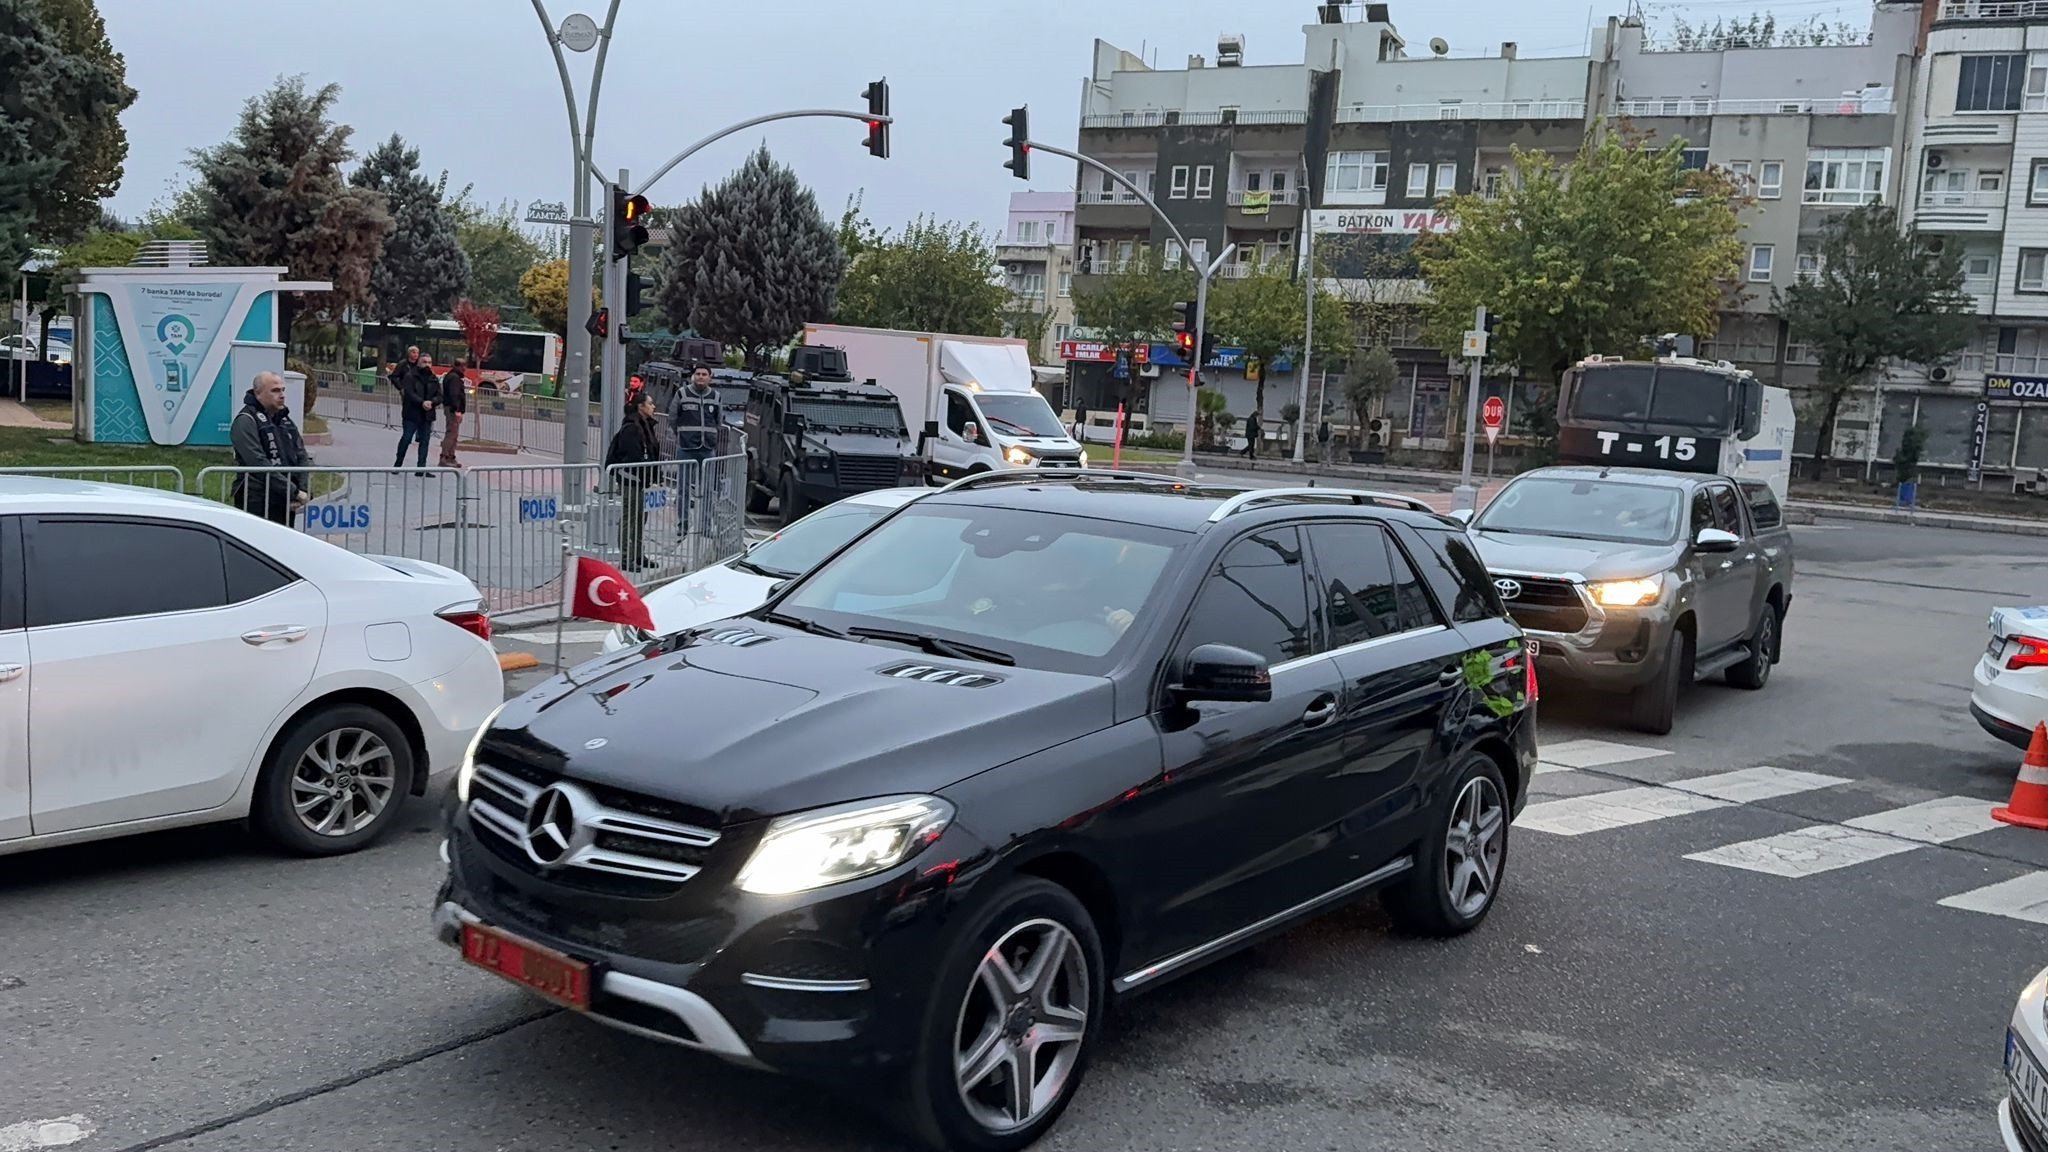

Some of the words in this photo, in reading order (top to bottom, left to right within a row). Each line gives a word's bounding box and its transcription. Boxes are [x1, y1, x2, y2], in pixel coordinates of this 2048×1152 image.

[1338, 215, 1394, 228] BATKON
[1989, 378, 2010, 388] DM
[2013, 382, 2048, 397] OZA
[1484, 406, 1502, 417] DUR
[1655, 435, 1696, 461] 15
